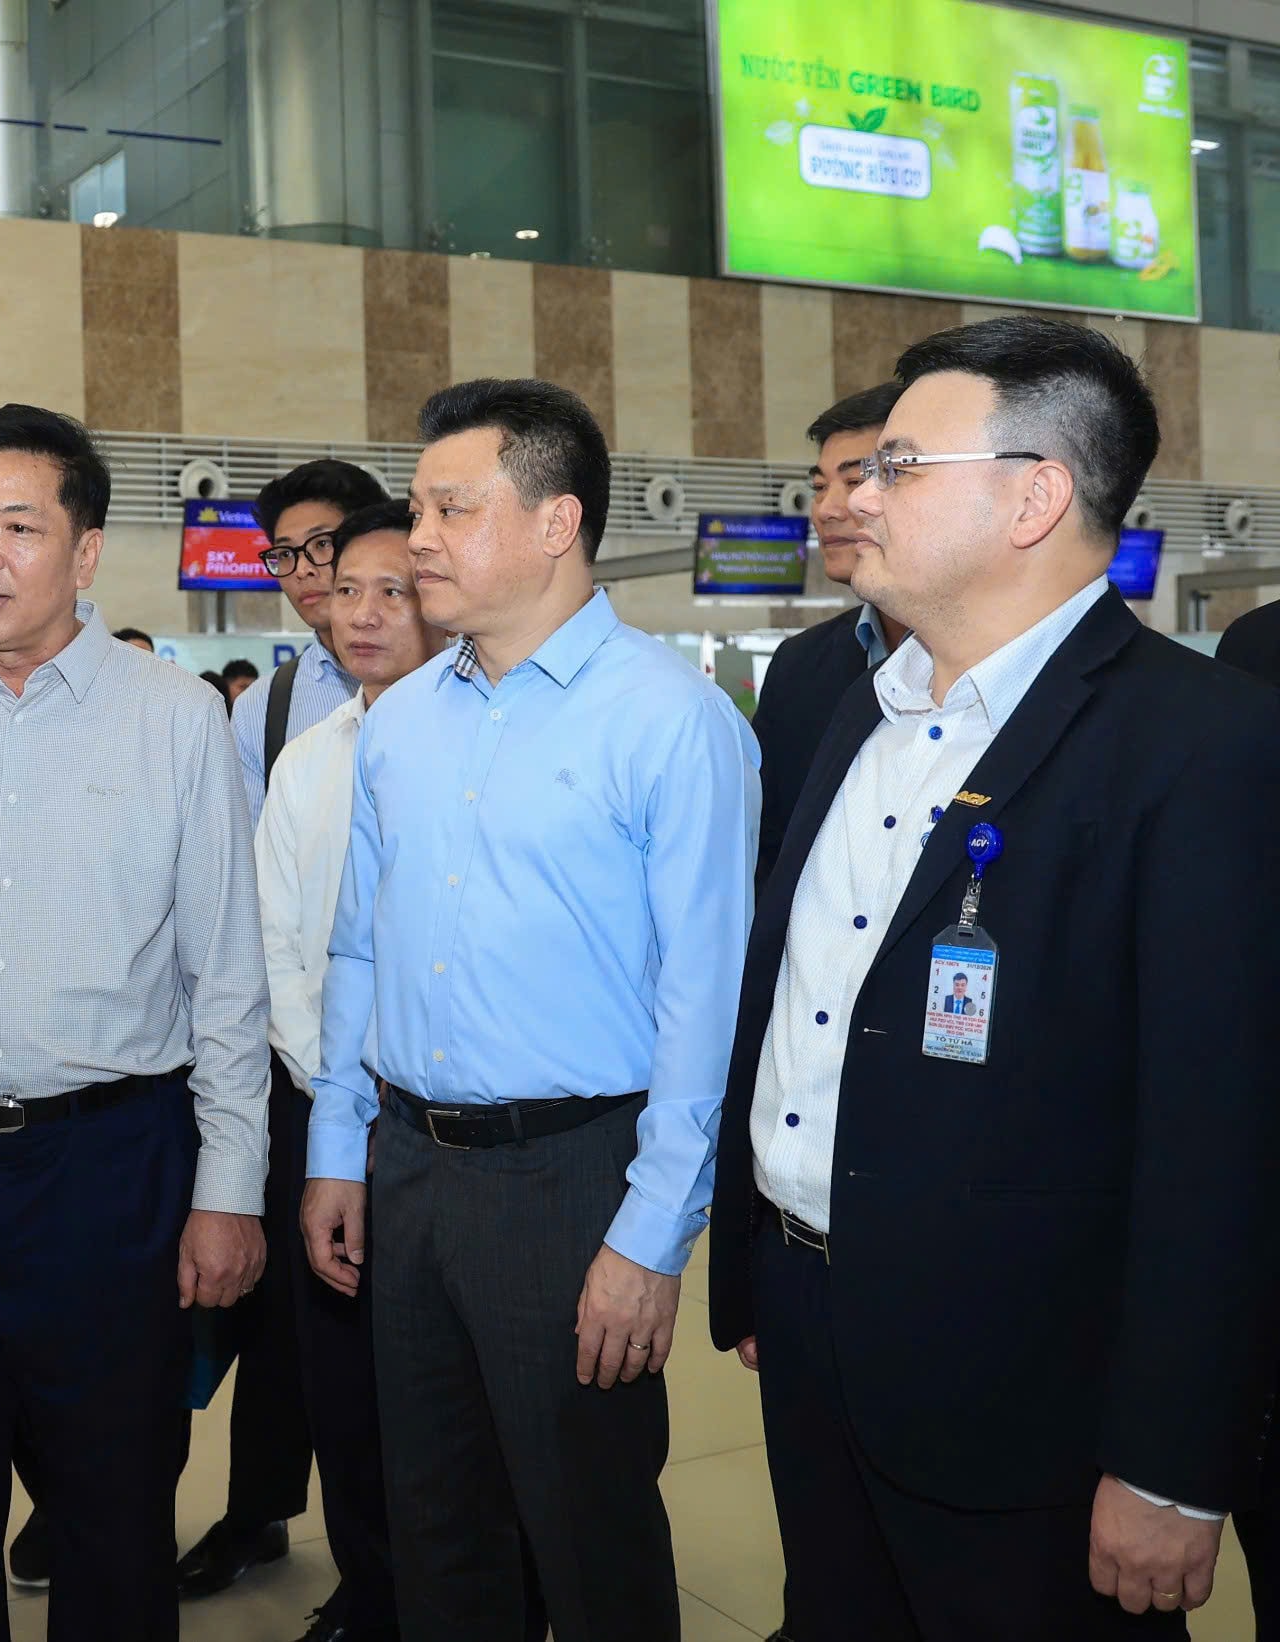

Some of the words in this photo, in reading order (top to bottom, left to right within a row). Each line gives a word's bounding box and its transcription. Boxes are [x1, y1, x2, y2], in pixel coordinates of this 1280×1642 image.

[848, 71, 922, 103] GREEN
[931, 84, 981, 112] BIRD
[933, 985, 939, 994] 2
[980, 991, 986, 1000] 5
[931, 1001, 937, 1010] 3
[979, 1008, 985, 1017] 6
